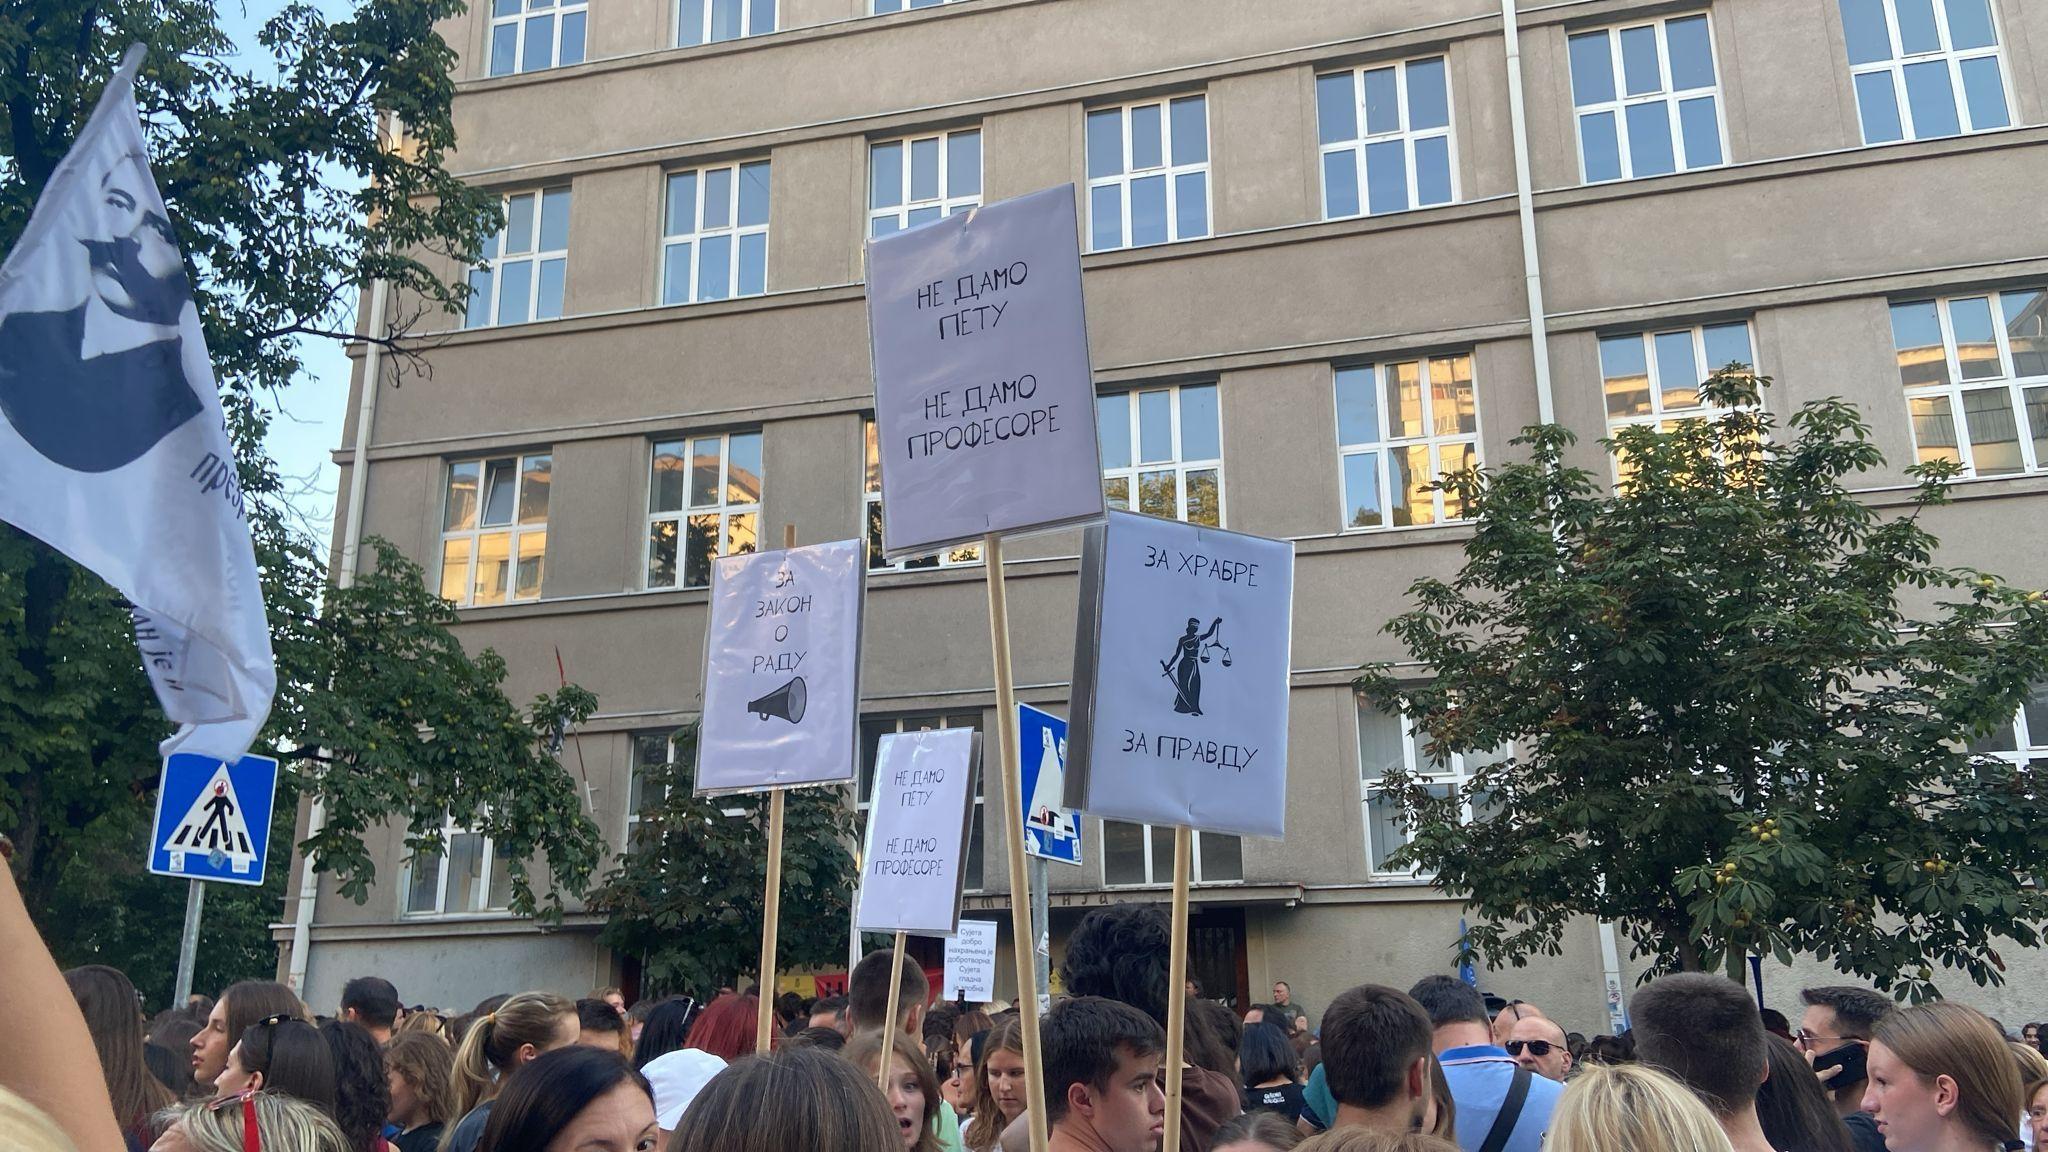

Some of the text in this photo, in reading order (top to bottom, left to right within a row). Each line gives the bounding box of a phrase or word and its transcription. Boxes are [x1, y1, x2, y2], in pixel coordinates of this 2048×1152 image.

[917, 261, 1029, 310] НЕ ДАМО
[938, 300, 1009, 340] ПЕТУ
[924, 374, 1038, 421] НЕ ДАМО
[907, 405, 1061, 460] ПРОФЕСОРЕ
[1143, 545, 1260, 588] ЗА ХРАБРЕ
[775, 570, 796, 589] ЗА
[755, 594, 813, 618] ЗАКОН
[774, 624, 790, 643] О
[752, 650, 808, 674] РАДУ
[1121, 729, 1259, 773] ЗА ПРАВДУ
[894, 768, 945, 788] НЕ ДАМО
[901, 790, 934, 807] ПЕТУ
[885, 837, 937, 856] НЕ ДАМО
[874, 859, 945, 877] ПРОФЕСОРЕ
[960, 928, 983, 937] Сујета
[961, 937, 983, 946] добро
[948, 947, 987, 955] нахрањена
[959, 965, 981, 974] Сујета
